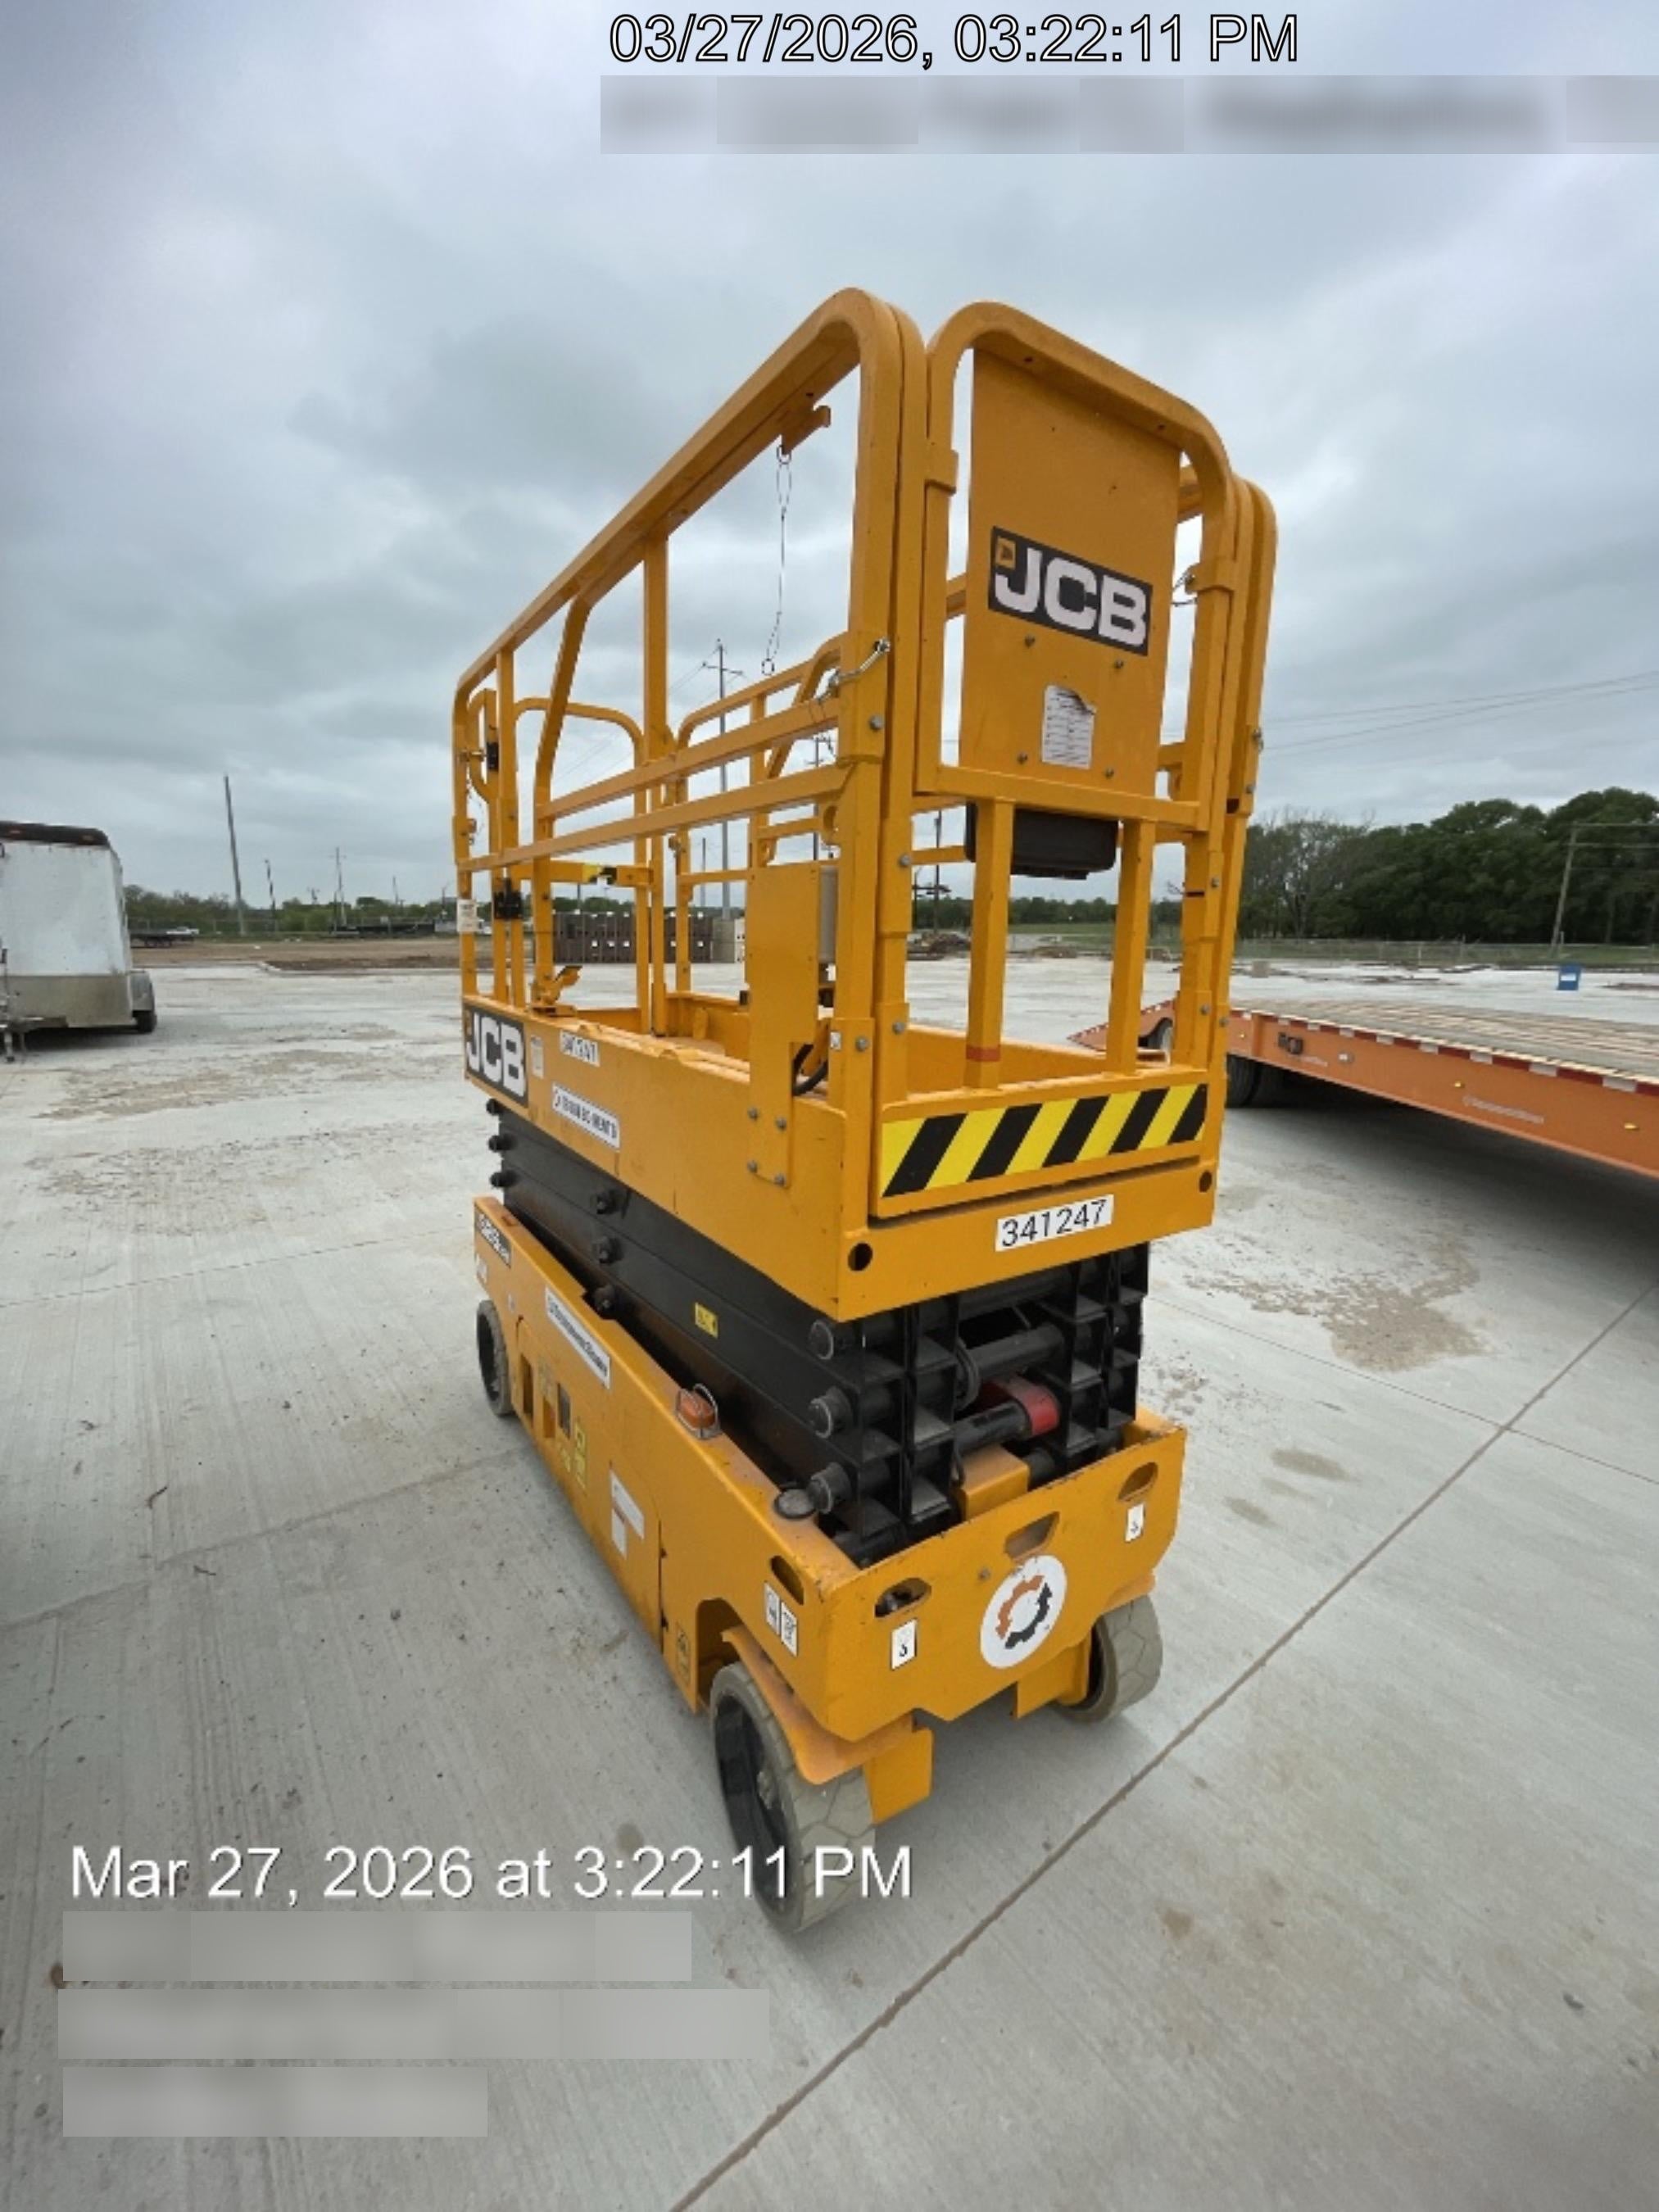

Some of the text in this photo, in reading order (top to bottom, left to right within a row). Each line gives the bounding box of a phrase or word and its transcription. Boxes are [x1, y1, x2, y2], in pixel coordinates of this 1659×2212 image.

[995, 547, 1146, 646] JCB
[466, 1012, 526, 1097] JCB
[1002, 1199, 1107, 1246] 341247
